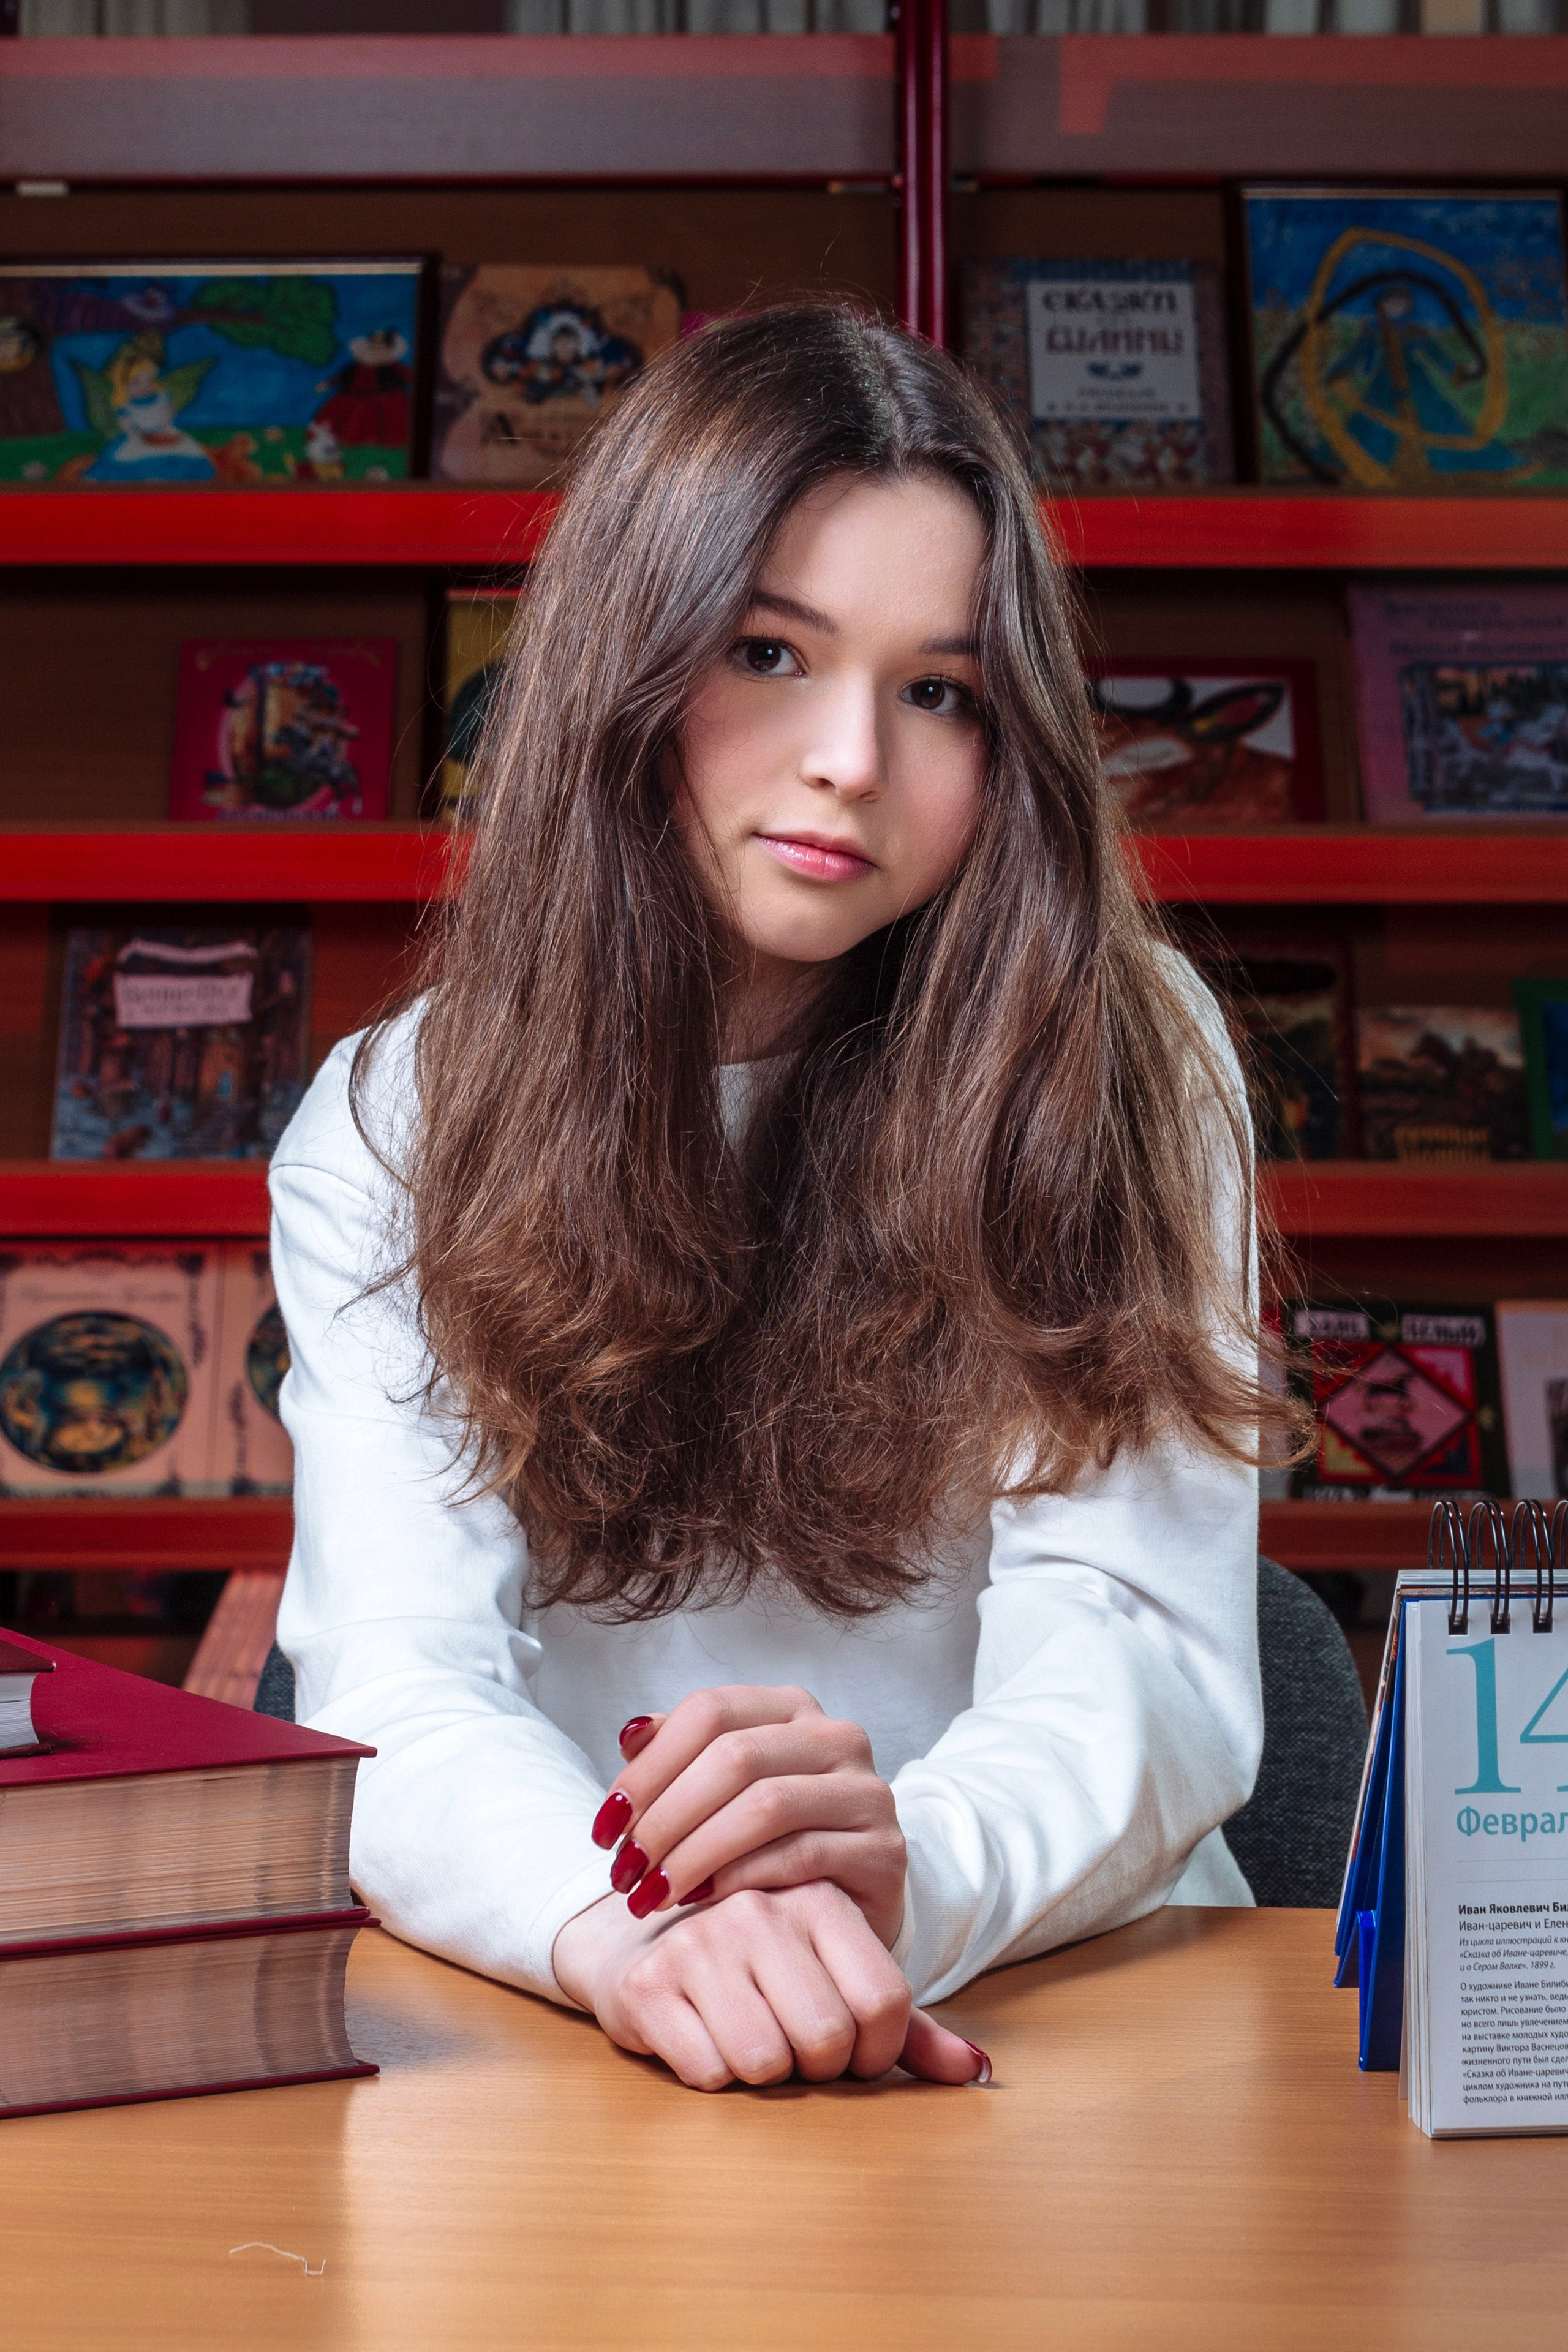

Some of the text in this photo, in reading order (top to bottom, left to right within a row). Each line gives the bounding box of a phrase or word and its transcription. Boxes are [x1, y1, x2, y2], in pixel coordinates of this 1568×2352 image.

[1458, 1902, 1568, 1915] Иван Яковлевич Би
[1459, 1921, 1531, 1932] Иван-царевич
[1470, 1939, 1494, 1947] цикла
[1496, 1936, 1552, 1946] иллюстраций
[1460, 1950, 1490, 1959] «Сказка
[1491, 1949, 1501, 1958] об
[1473, 1962, 1498, 1972] Сером
[1531, 1961, 1549, 1969] 1899
[1460, 1982, 1467, 1991] О
[1469, 1982, 1512, 1992] художнике
[1514, 1980, 1539, 1989] Иване
[1520, 1994, 1548, 2003] узнать,
[1461, 2005, 1566, 2017] юристом. Рисование было
[1512, 2031, 1548, 2040] молодых
[1462, 2045, 1494, 2054] картину
[1496, 2043, 1529, 2053] Виктора
[1461, 2057, 1510, 2065] жизненного
[1513, 2057, 1531, 2065] пути
[1533, 2055, 1548, 2064] был
[1463, 2070, 1494, 2078] «Сказка
[1496, 2068, 1506, 2077] об
[1463, 2083, 1494, 2092] циклом
[1496, 2082, 1539, 2091] художника
[1463, 2095, 1507, 2105] фольклора
[1517, 2092, 1552, 2101] книжной
